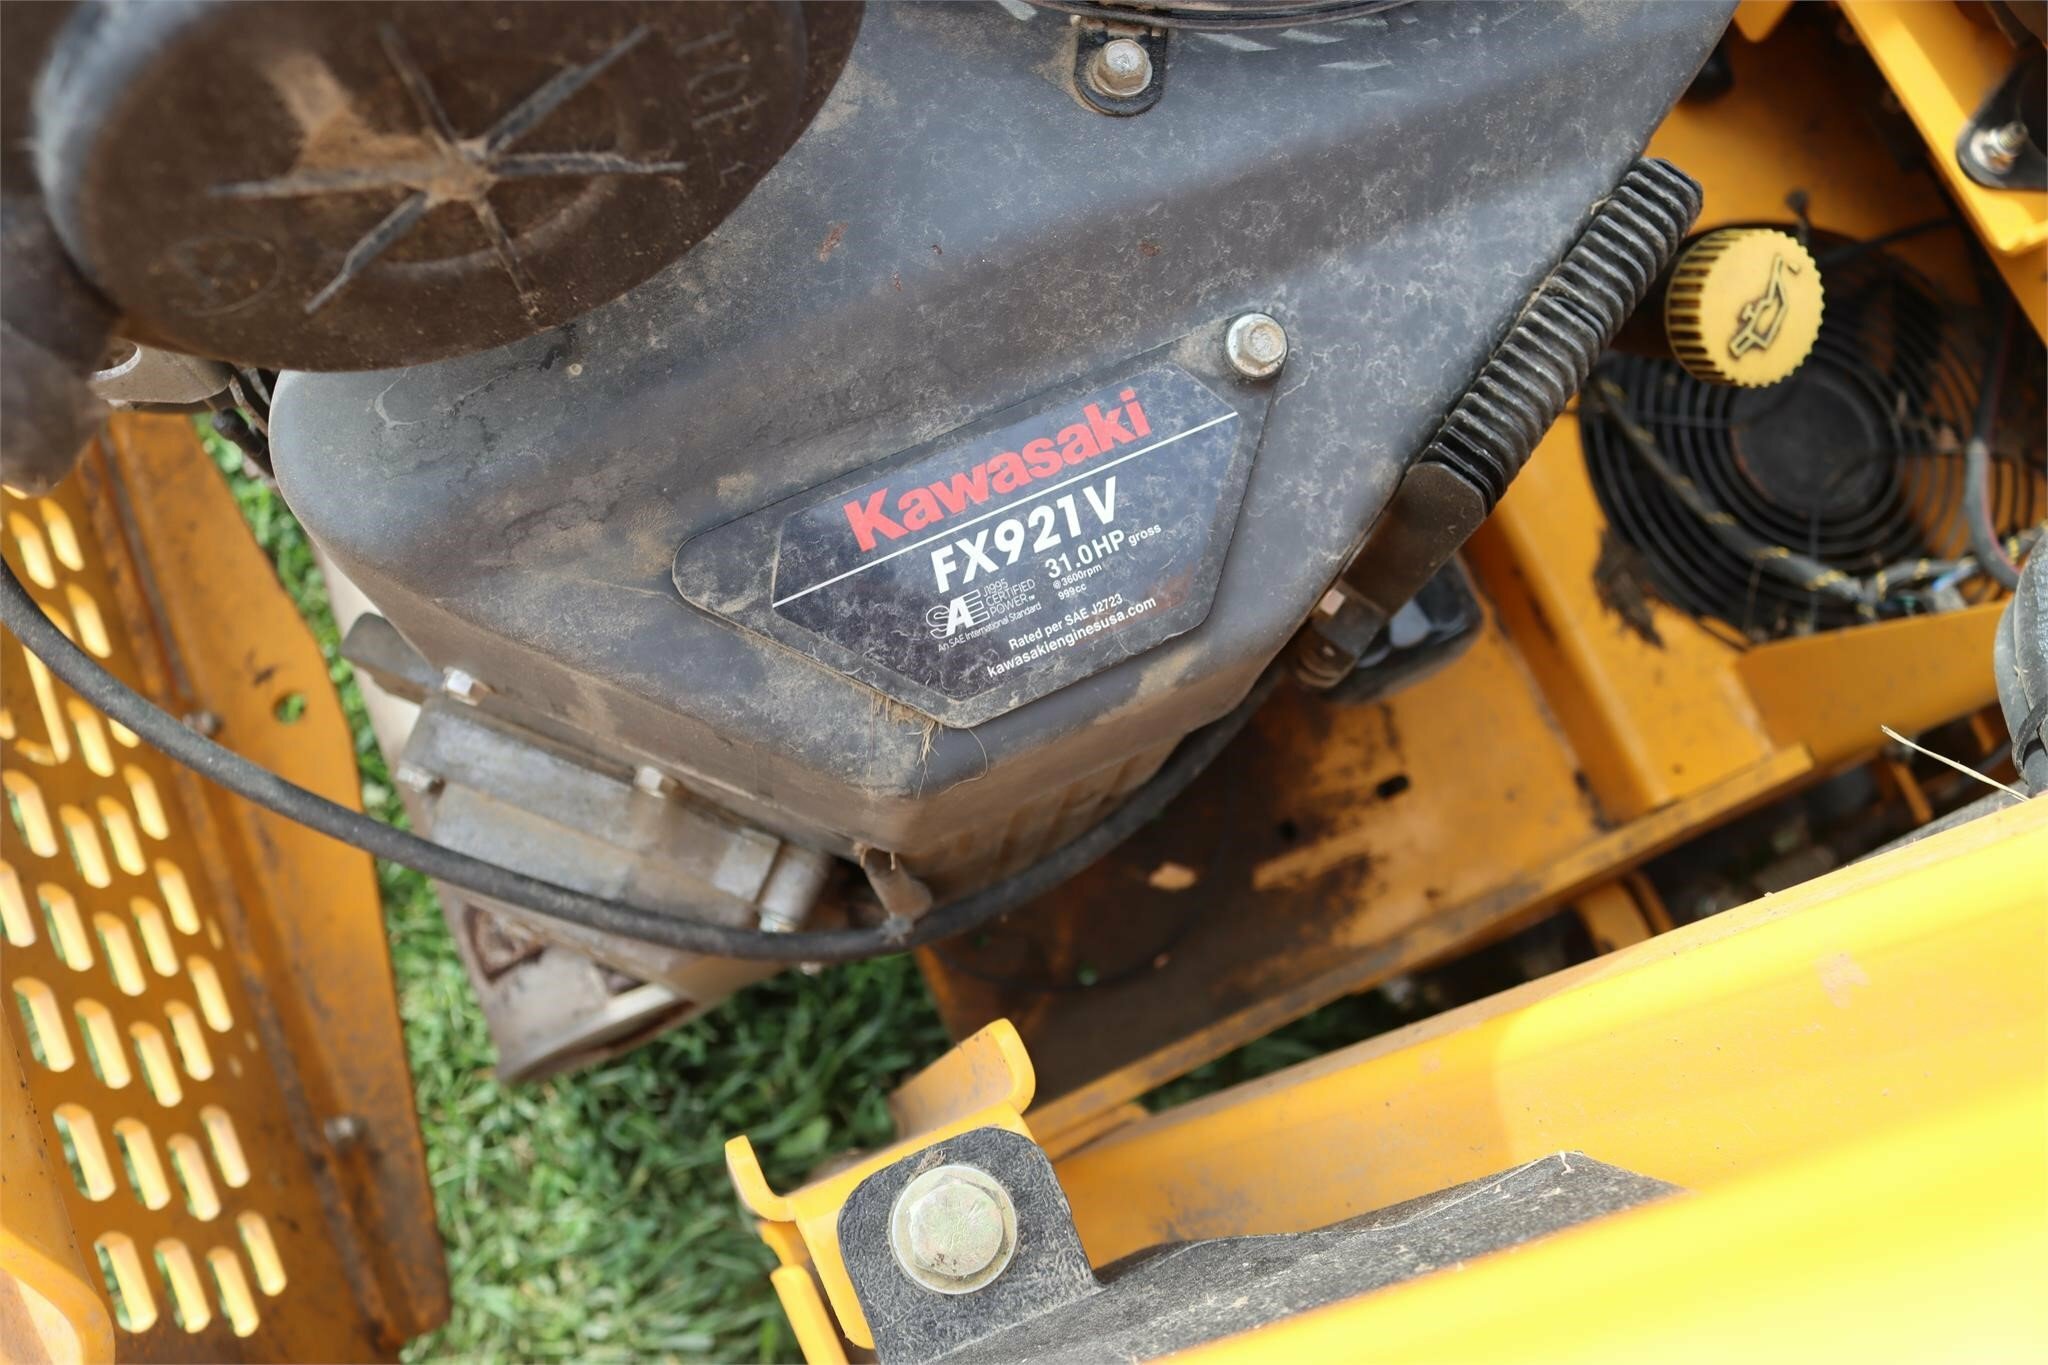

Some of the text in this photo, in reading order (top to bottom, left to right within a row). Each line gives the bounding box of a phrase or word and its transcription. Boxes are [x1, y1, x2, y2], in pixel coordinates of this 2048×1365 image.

[843, 388, 1151, 552] Kawasaki
[930, 476, 1116, 593] FX921V
[1128, 524, 1162, 547] gross
[983, 577, 1009, 598] J1995
[985, 578, 1036, 607] CERTIFIED
[1058, 583, 1087, 601] 999cc
[926, 589, 991, 639] SAE
[938, 601, 1042, 653] An SAE International Standard
[987, 597, 1158, 678] kawasakienginesusa.com
[1008, 593, 1123, 651] Rated per SAE J2723
